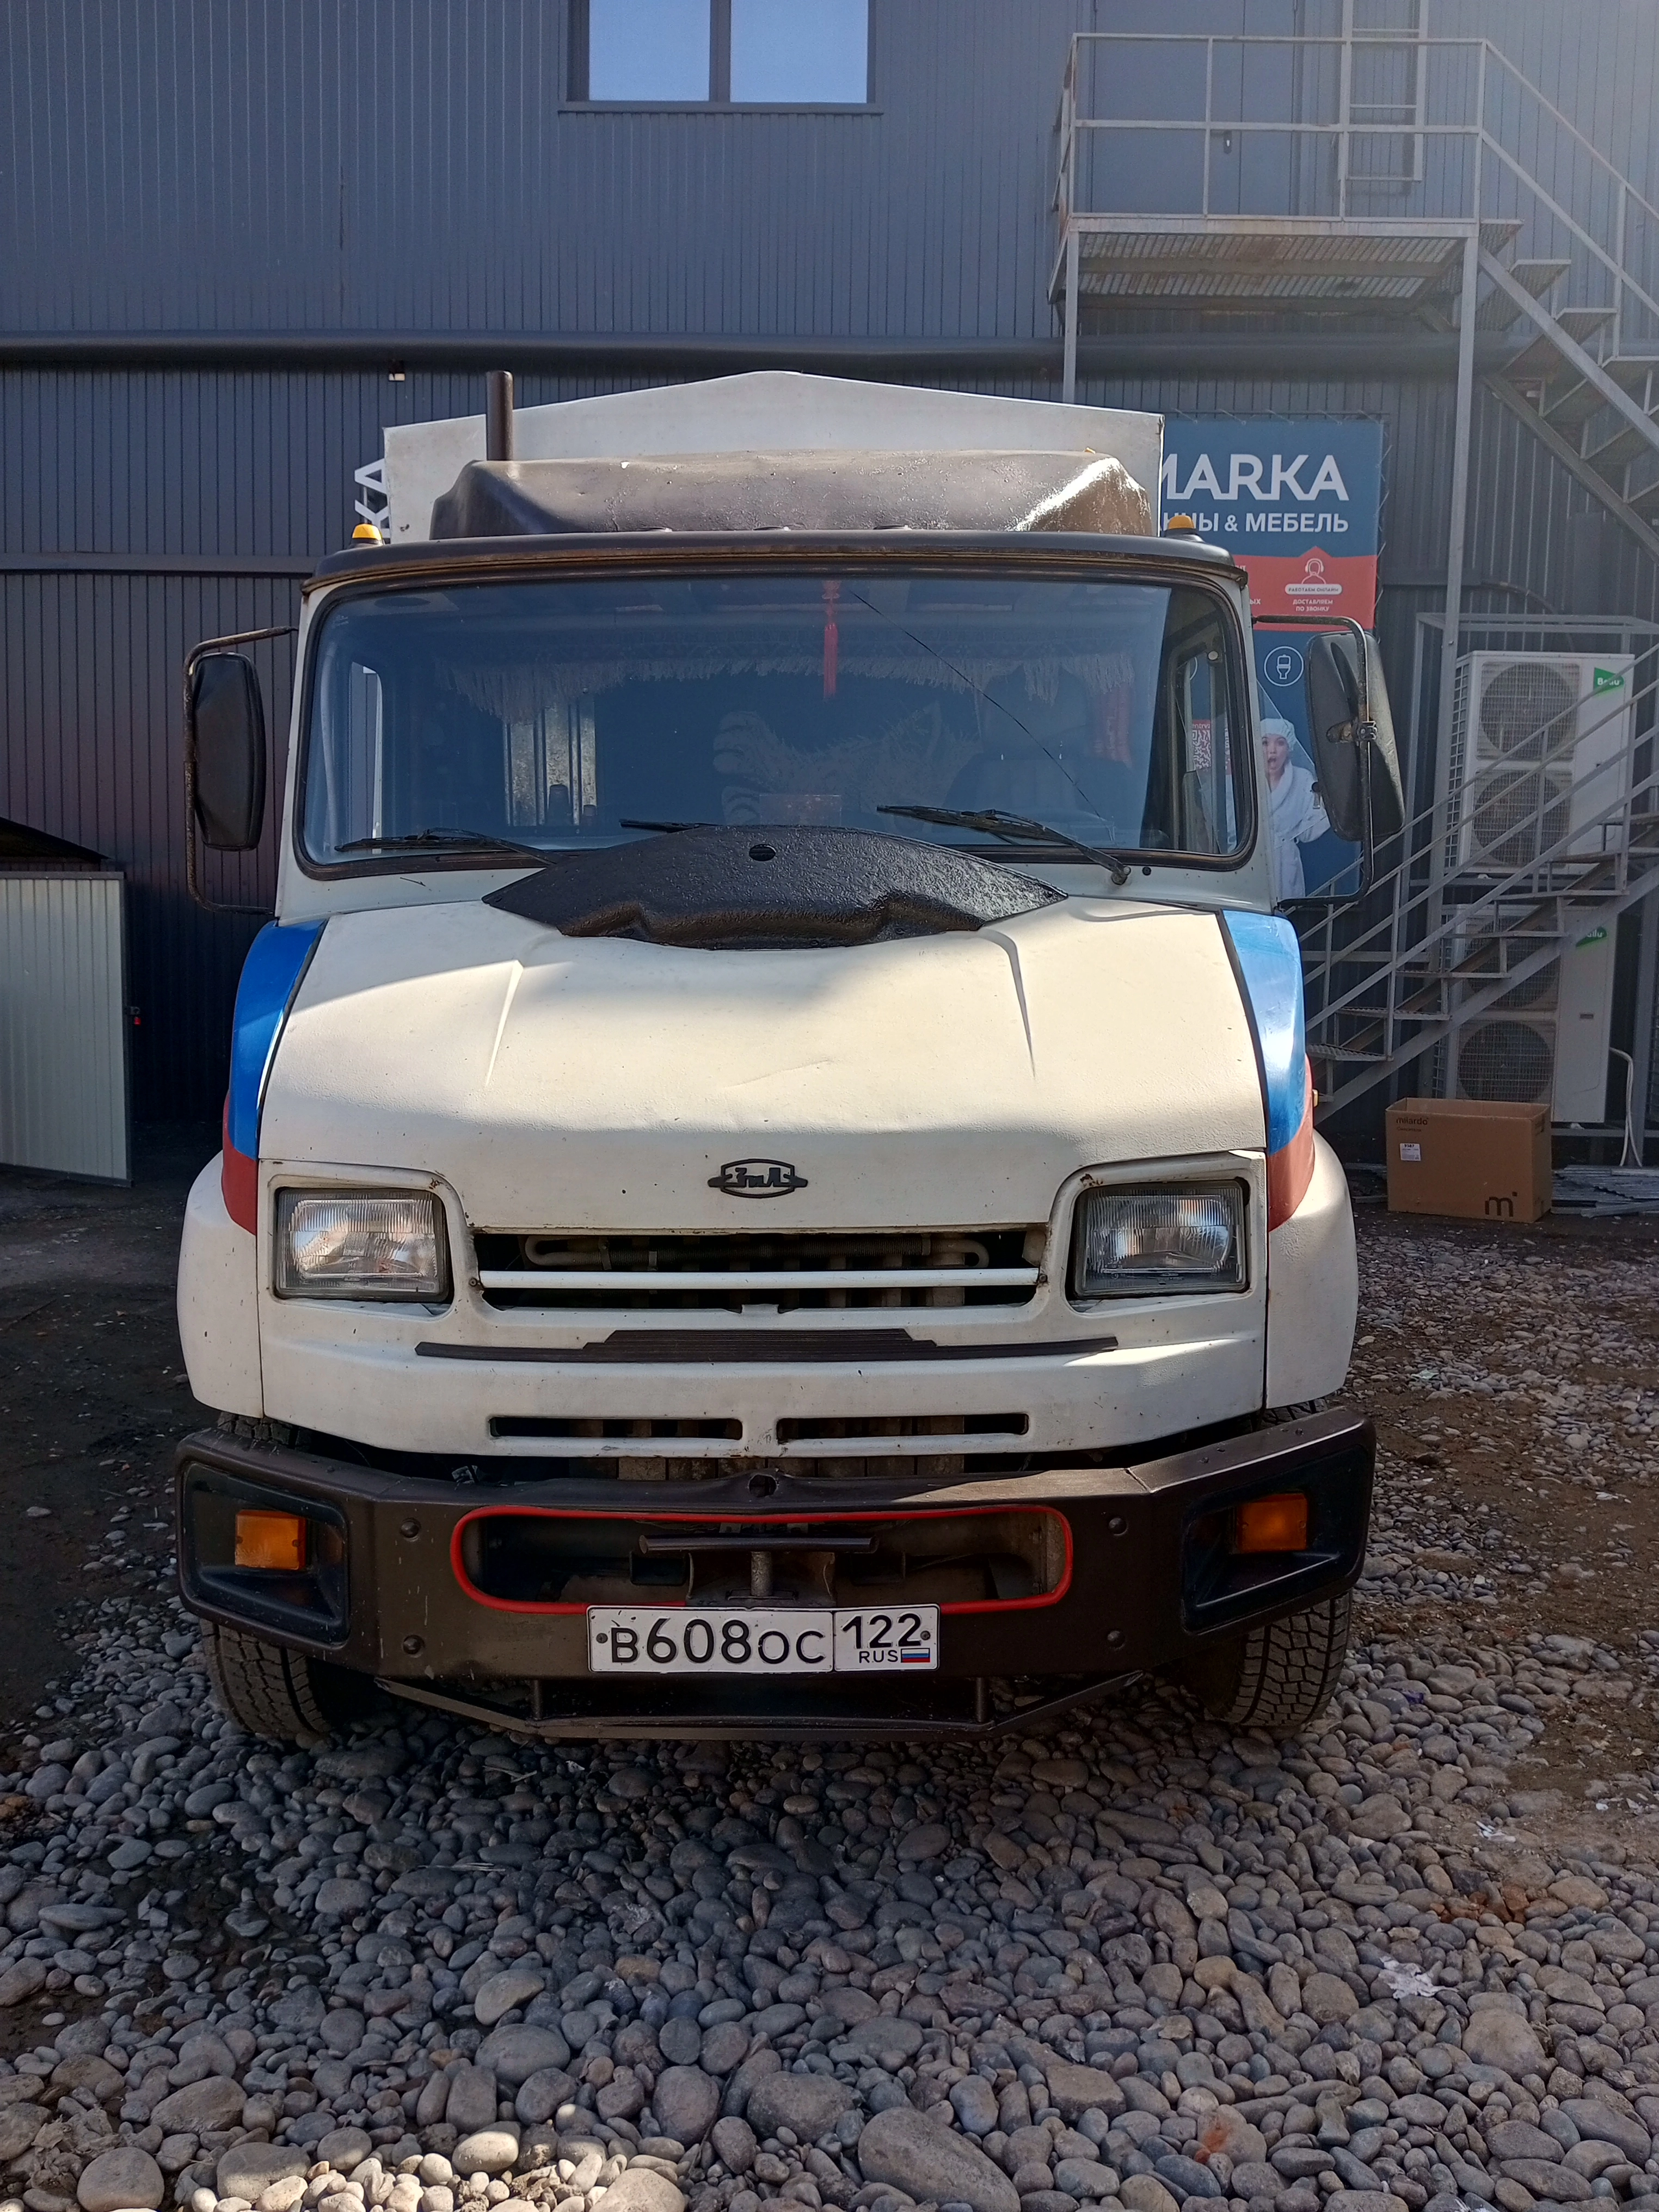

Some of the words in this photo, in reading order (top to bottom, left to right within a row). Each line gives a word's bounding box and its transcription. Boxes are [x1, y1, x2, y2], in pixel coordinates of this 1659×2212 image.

[1225, 514, 1238, 532] &
[1245, 513, 1349, 533] МЕБЕЛЬ
[1396, 1116, 1428, 1125] milardo
[840, 1613, 921, 1649] 122
[858, 1650, 899, 1664] RUS
